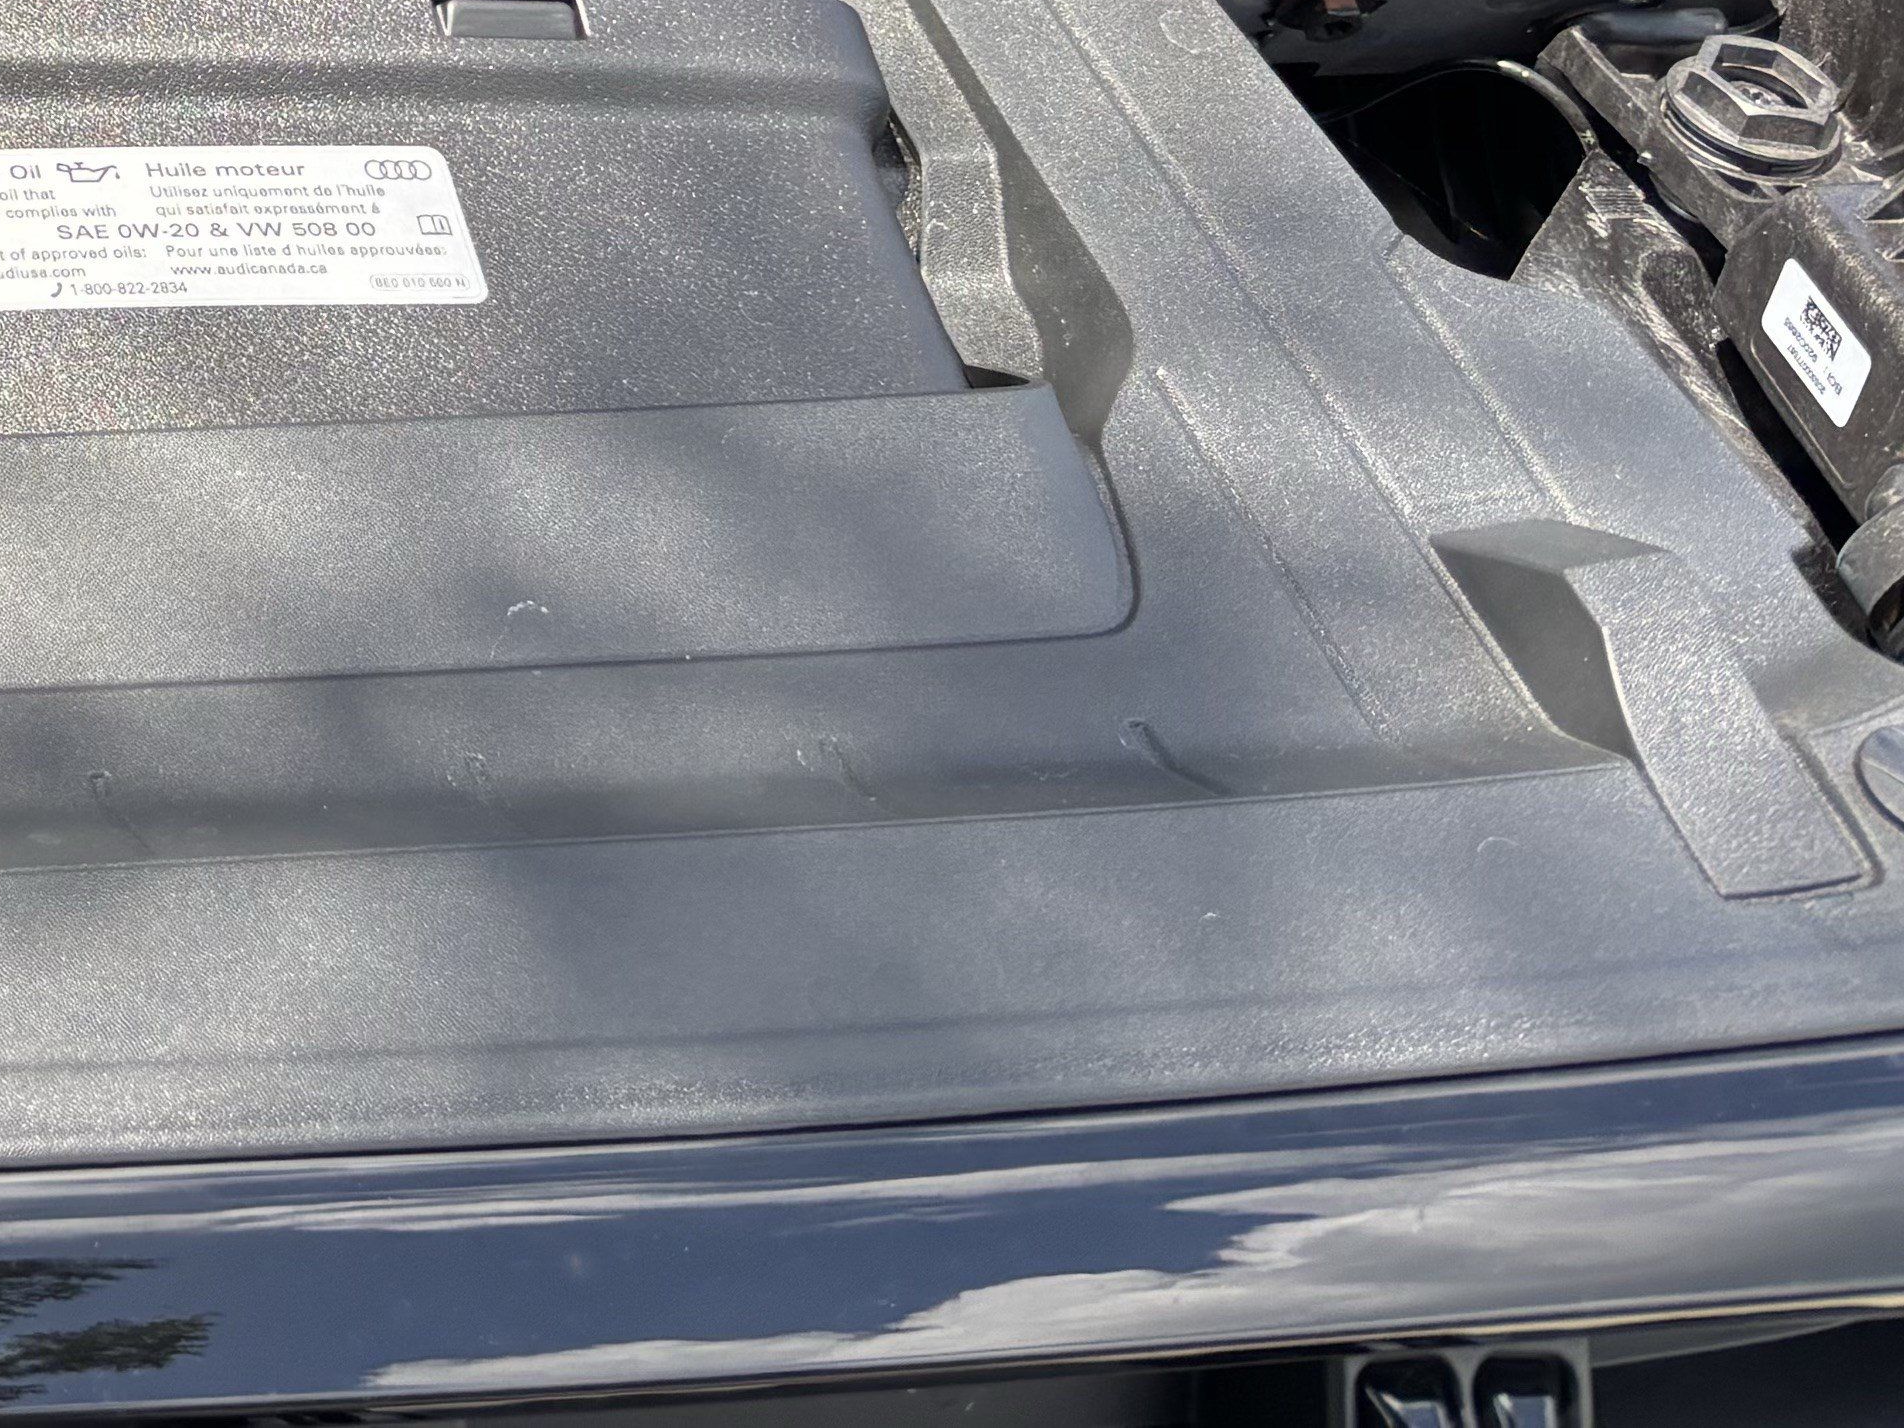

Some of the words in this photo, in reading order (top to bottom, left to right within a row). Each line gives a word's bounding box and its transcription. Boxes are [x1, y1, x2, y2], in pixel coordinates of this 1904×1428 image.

[10, 165, 41, 179] Oil
[145, 162, 206, 178] Huile
[215, 162, 305, 177] moteur
[0, 189, 18, 201] oil
[23, 189, 55, 200] that
[213, 186, 309, 199] uniquement
[314, 185, 332, 196] de
[6, 206, 77, 219] complies
[82, 205, 116, 217] with
[156, 204, 181, 217] qui
[57, 225, 109, 239] SAE
[210, 223, 227, 237] &
[237, 222, 281, 236] VW
[292, 222, 337, 236] 508
[346, 222, 375, 236] 00
[10, 248, 25, 260] of
[32, 247, 107, 262] approved
[166, 245, 202, 257] Pour
[209, 248, 238, 257] une
[243, 244, 276, 256] liste
[171, 263, 327, 275] www.audicanada.ca
[71, 282, 187, 295] 1-800-822-2834
